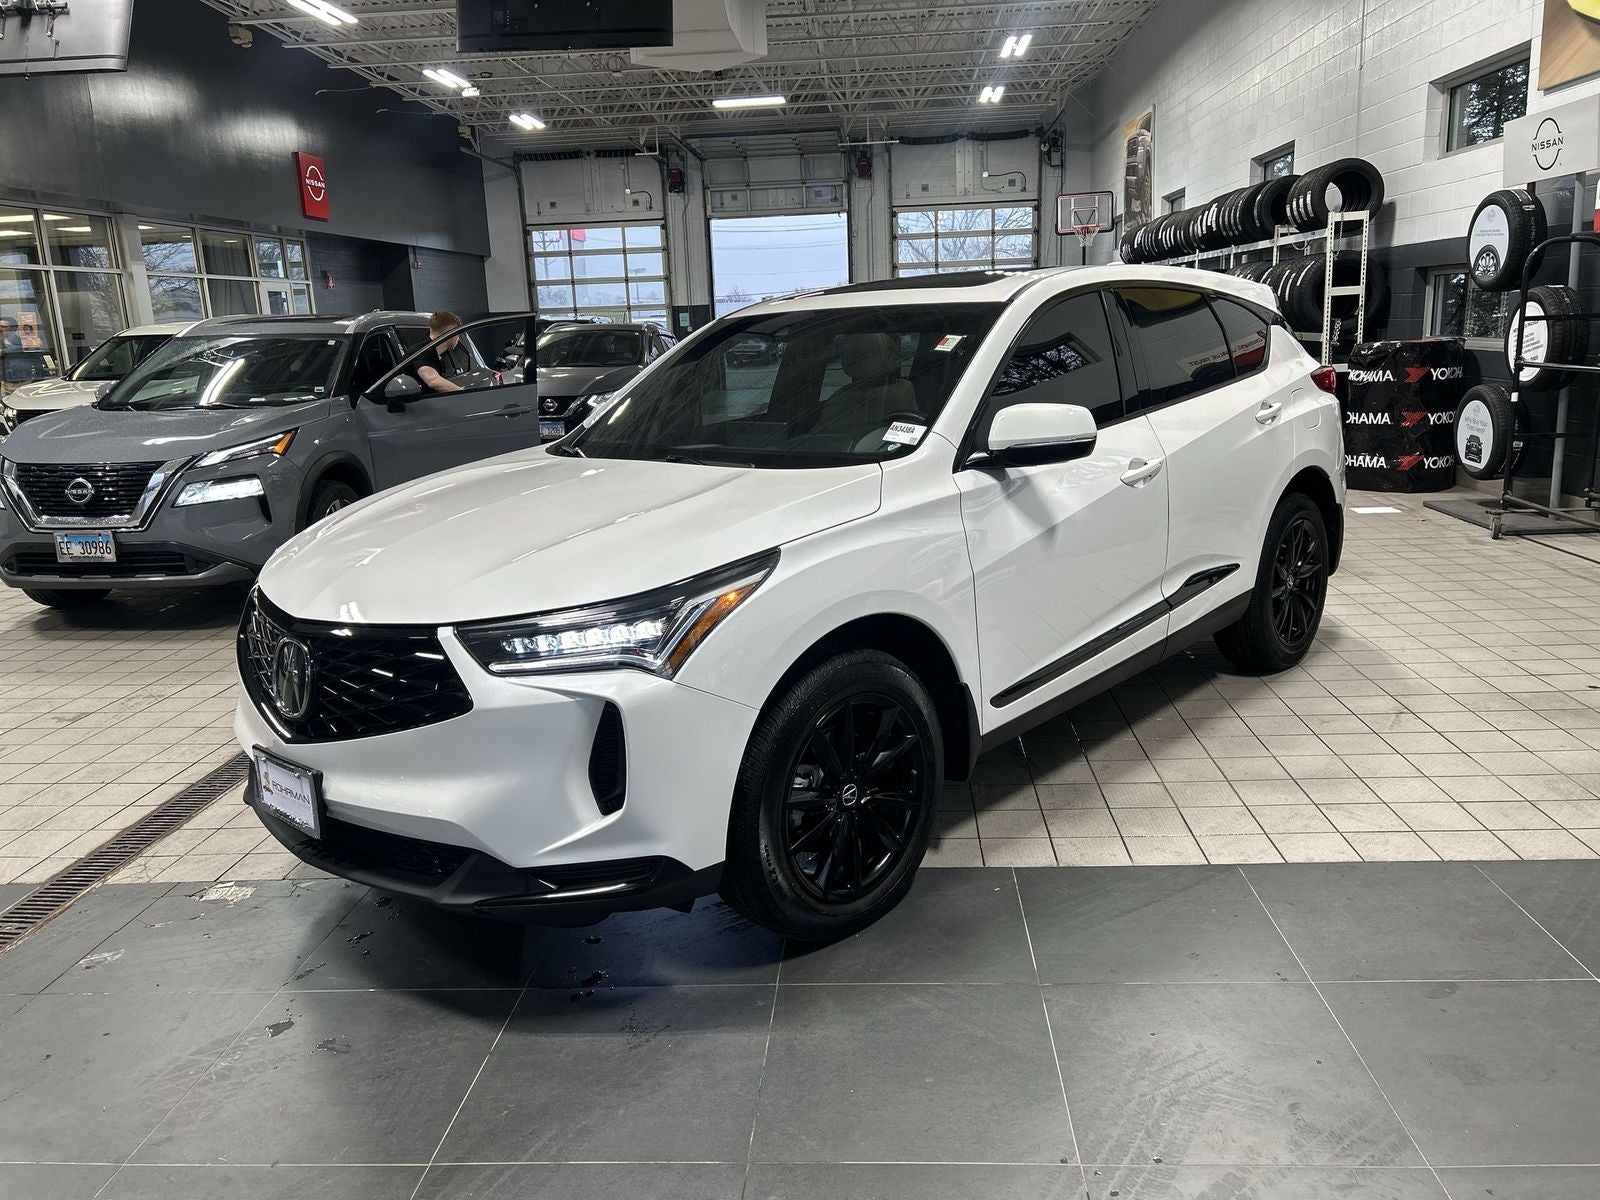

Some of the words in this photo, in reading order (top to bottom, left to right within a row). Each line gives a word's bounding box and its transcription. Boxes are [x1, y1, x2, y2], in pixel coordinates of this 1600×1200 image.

[1531, 136, 1564, 152] NISSAN
[305, 178, 326, 188] NISSAN
[1348, 369, 1395, 382] KOHAMA
[1430, 366, 1463, 381] YOKOH
[1427, 411, 1456, 425] YOKO
[1423, 455, 1455, 469] YOKOH
[58, 540, 74, 556] EE
[78, 540, 112, 555] 30986
[272, 780, 312, 806] ROHRMAN
